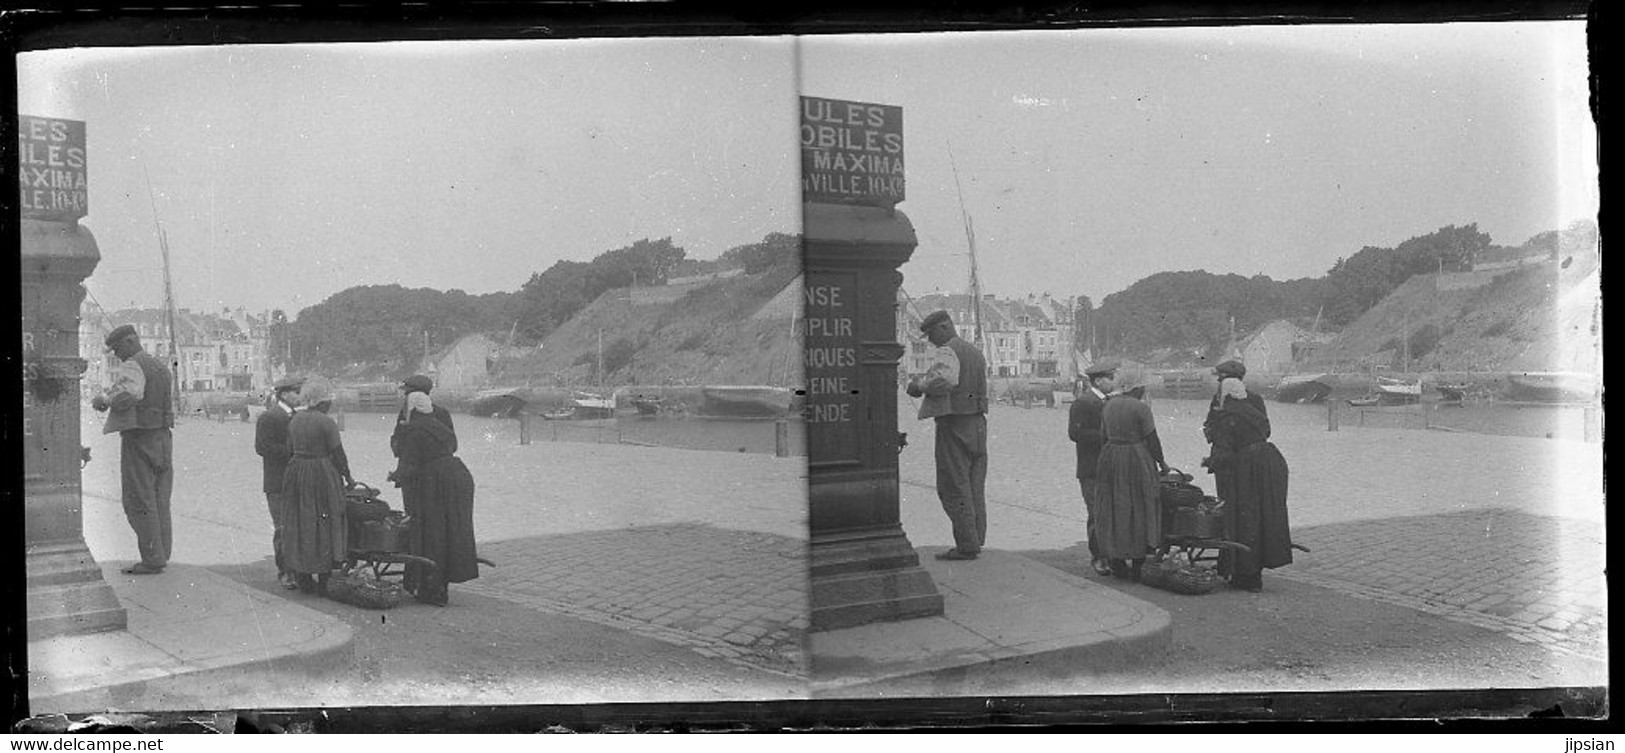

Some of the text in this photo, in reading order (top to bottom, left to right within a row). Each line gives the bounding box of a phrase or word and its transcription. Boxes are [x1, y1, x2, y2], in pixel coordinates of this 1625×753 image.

[804, 99, 884, 127] ULES
[800, 124, 901, 153] OBILES
[813, 151, 903, 175] MAXIMA
